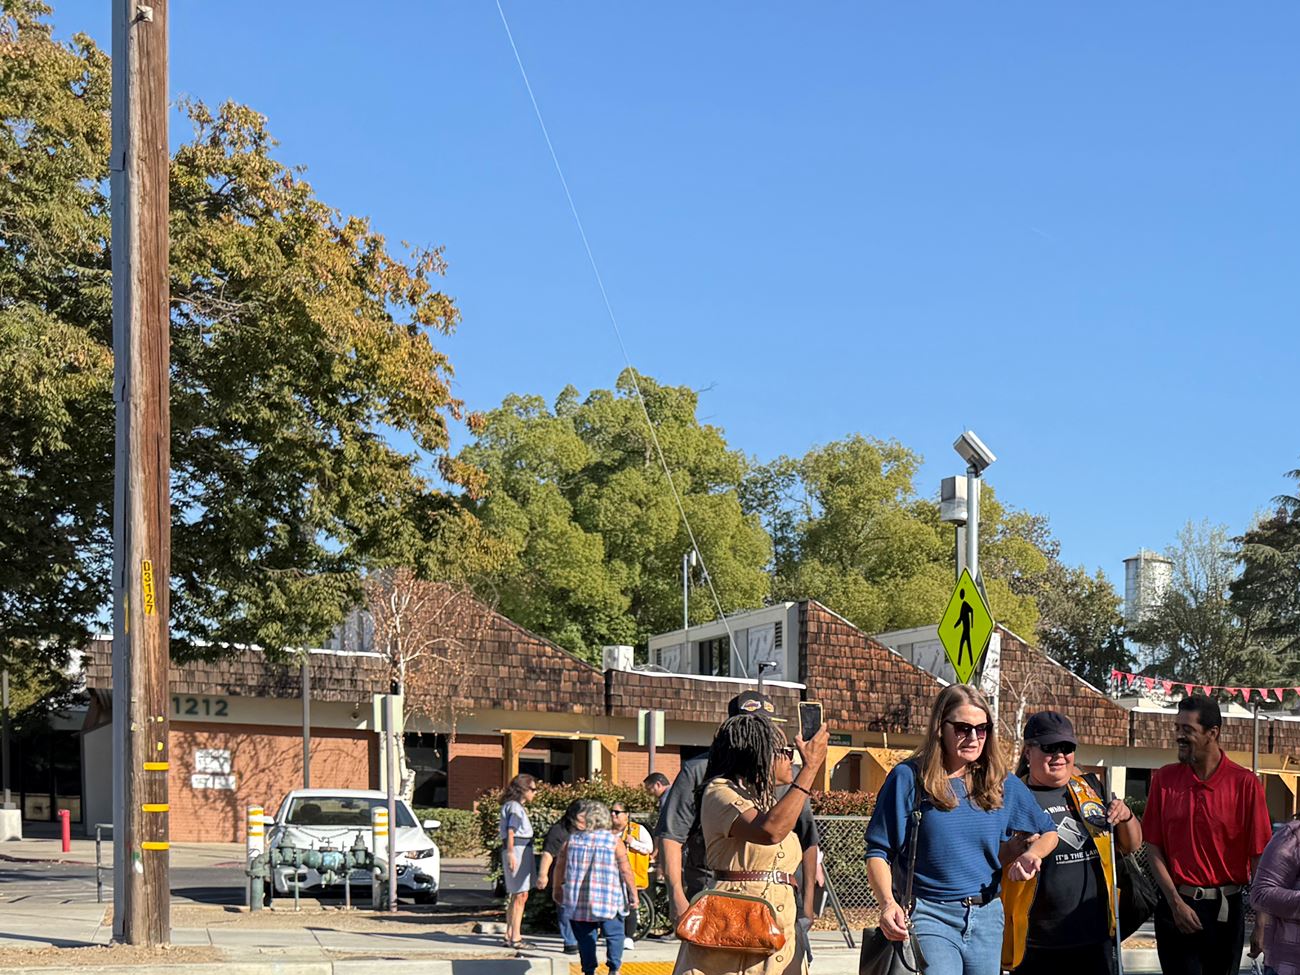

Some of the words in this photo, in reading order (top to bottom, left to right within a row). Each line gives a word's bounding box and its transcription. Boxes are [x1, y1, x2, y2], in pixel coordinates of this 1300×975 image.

[172, 696, 229, 717] 1212
[1055, 854, 1069, 862] IT'S
[1070, 851, 1084, 860] THE
